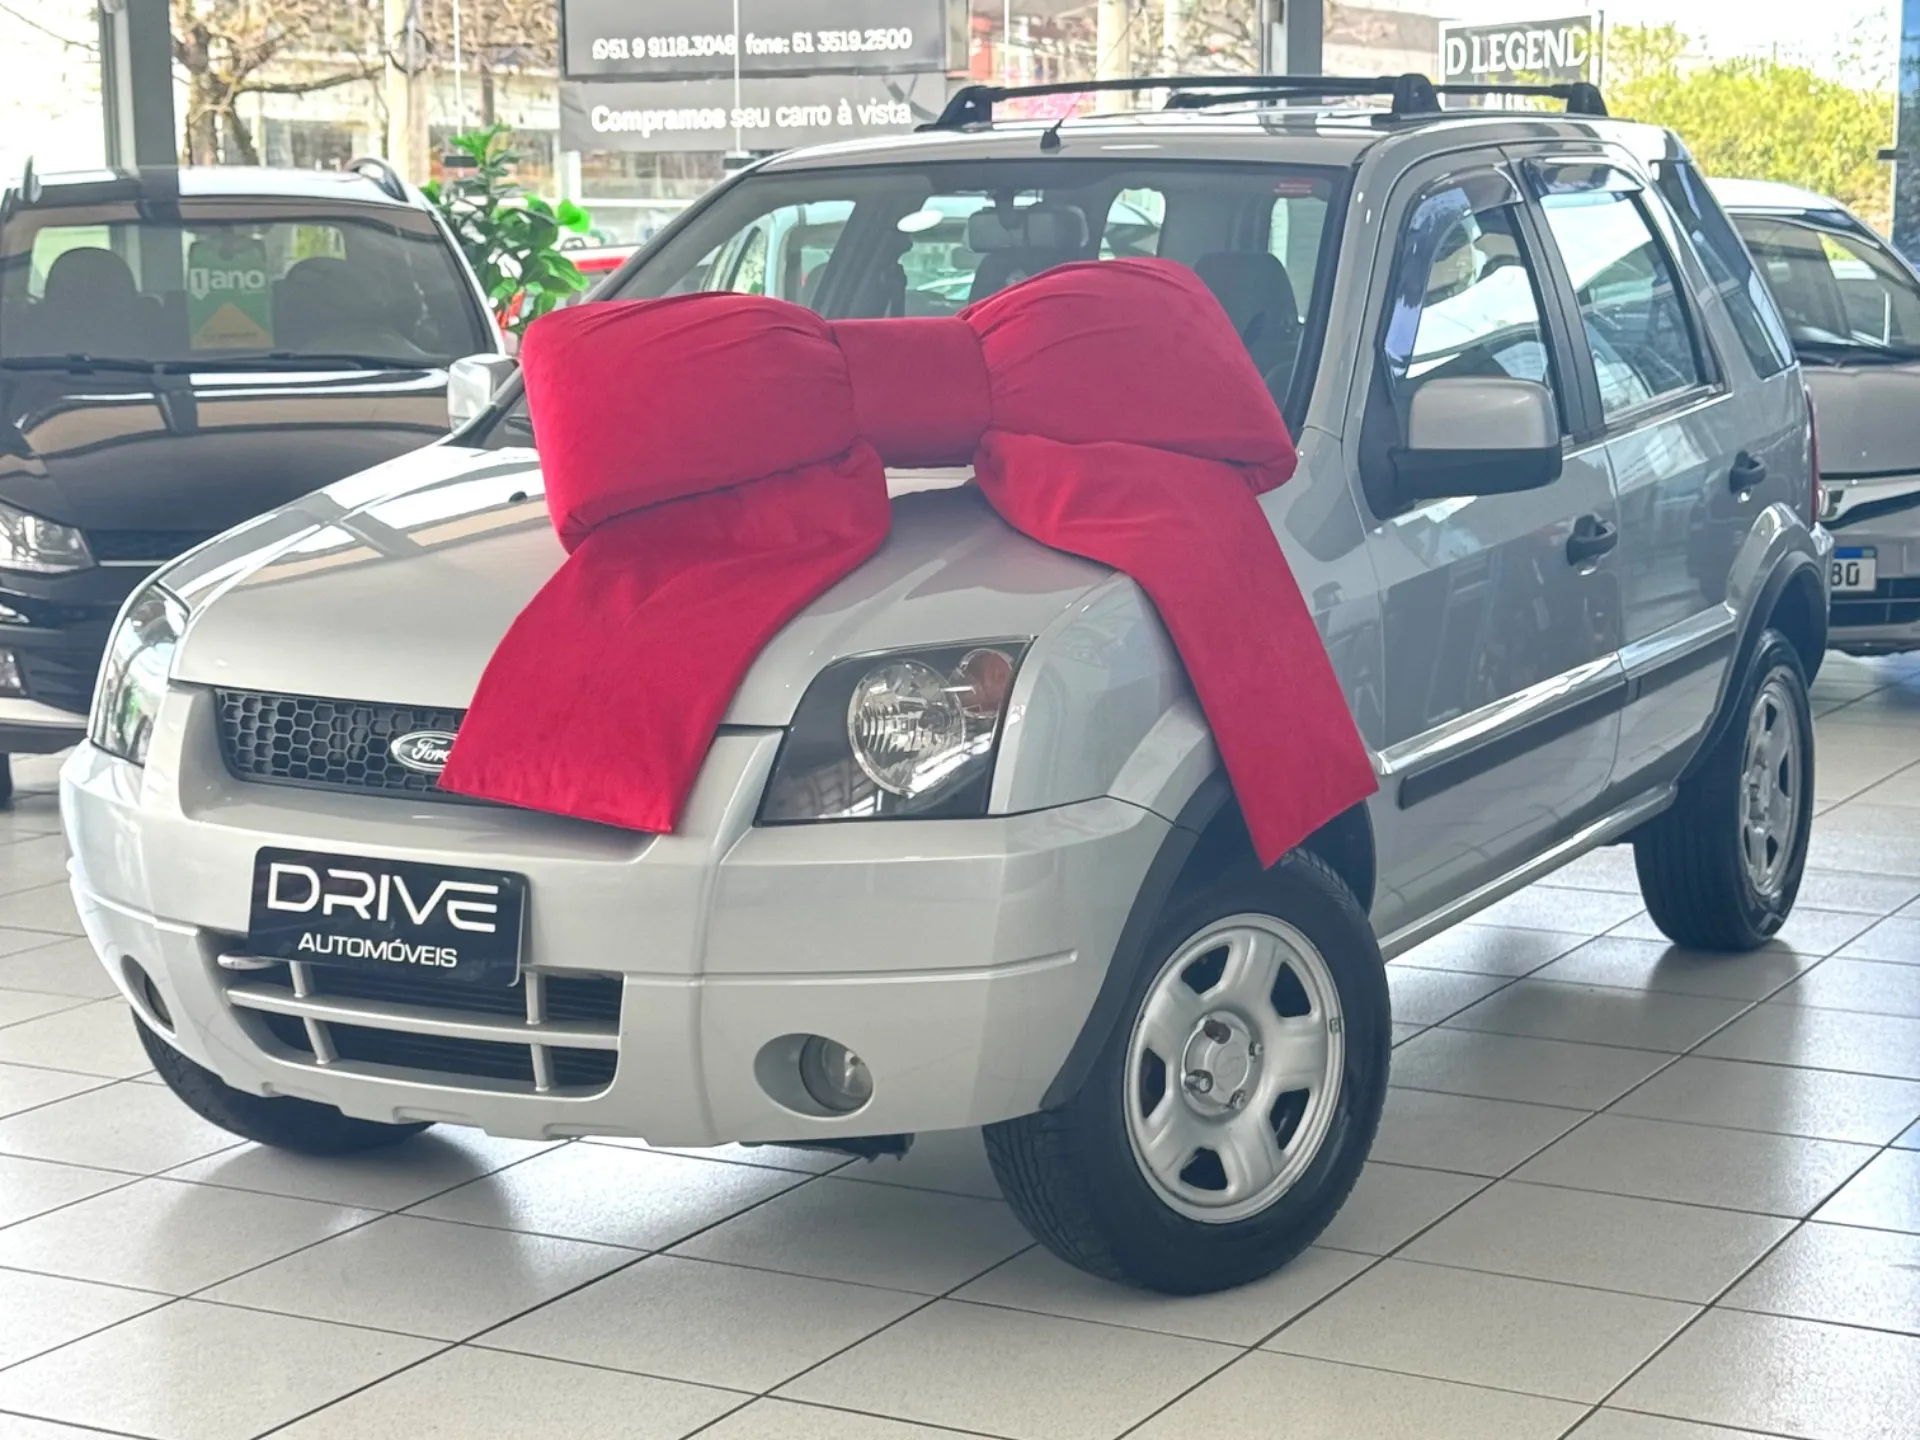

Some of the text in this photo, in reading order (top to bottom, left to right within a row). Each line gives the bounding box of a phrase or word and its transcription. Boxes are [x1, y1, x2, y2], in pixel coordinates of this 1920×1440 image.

[591, 97, 912, 138] Compramos seu carro à vista
[267, 862, 499, 933] DRIVE
[298, 932, 458, 968] AUTOMÓVEIS
